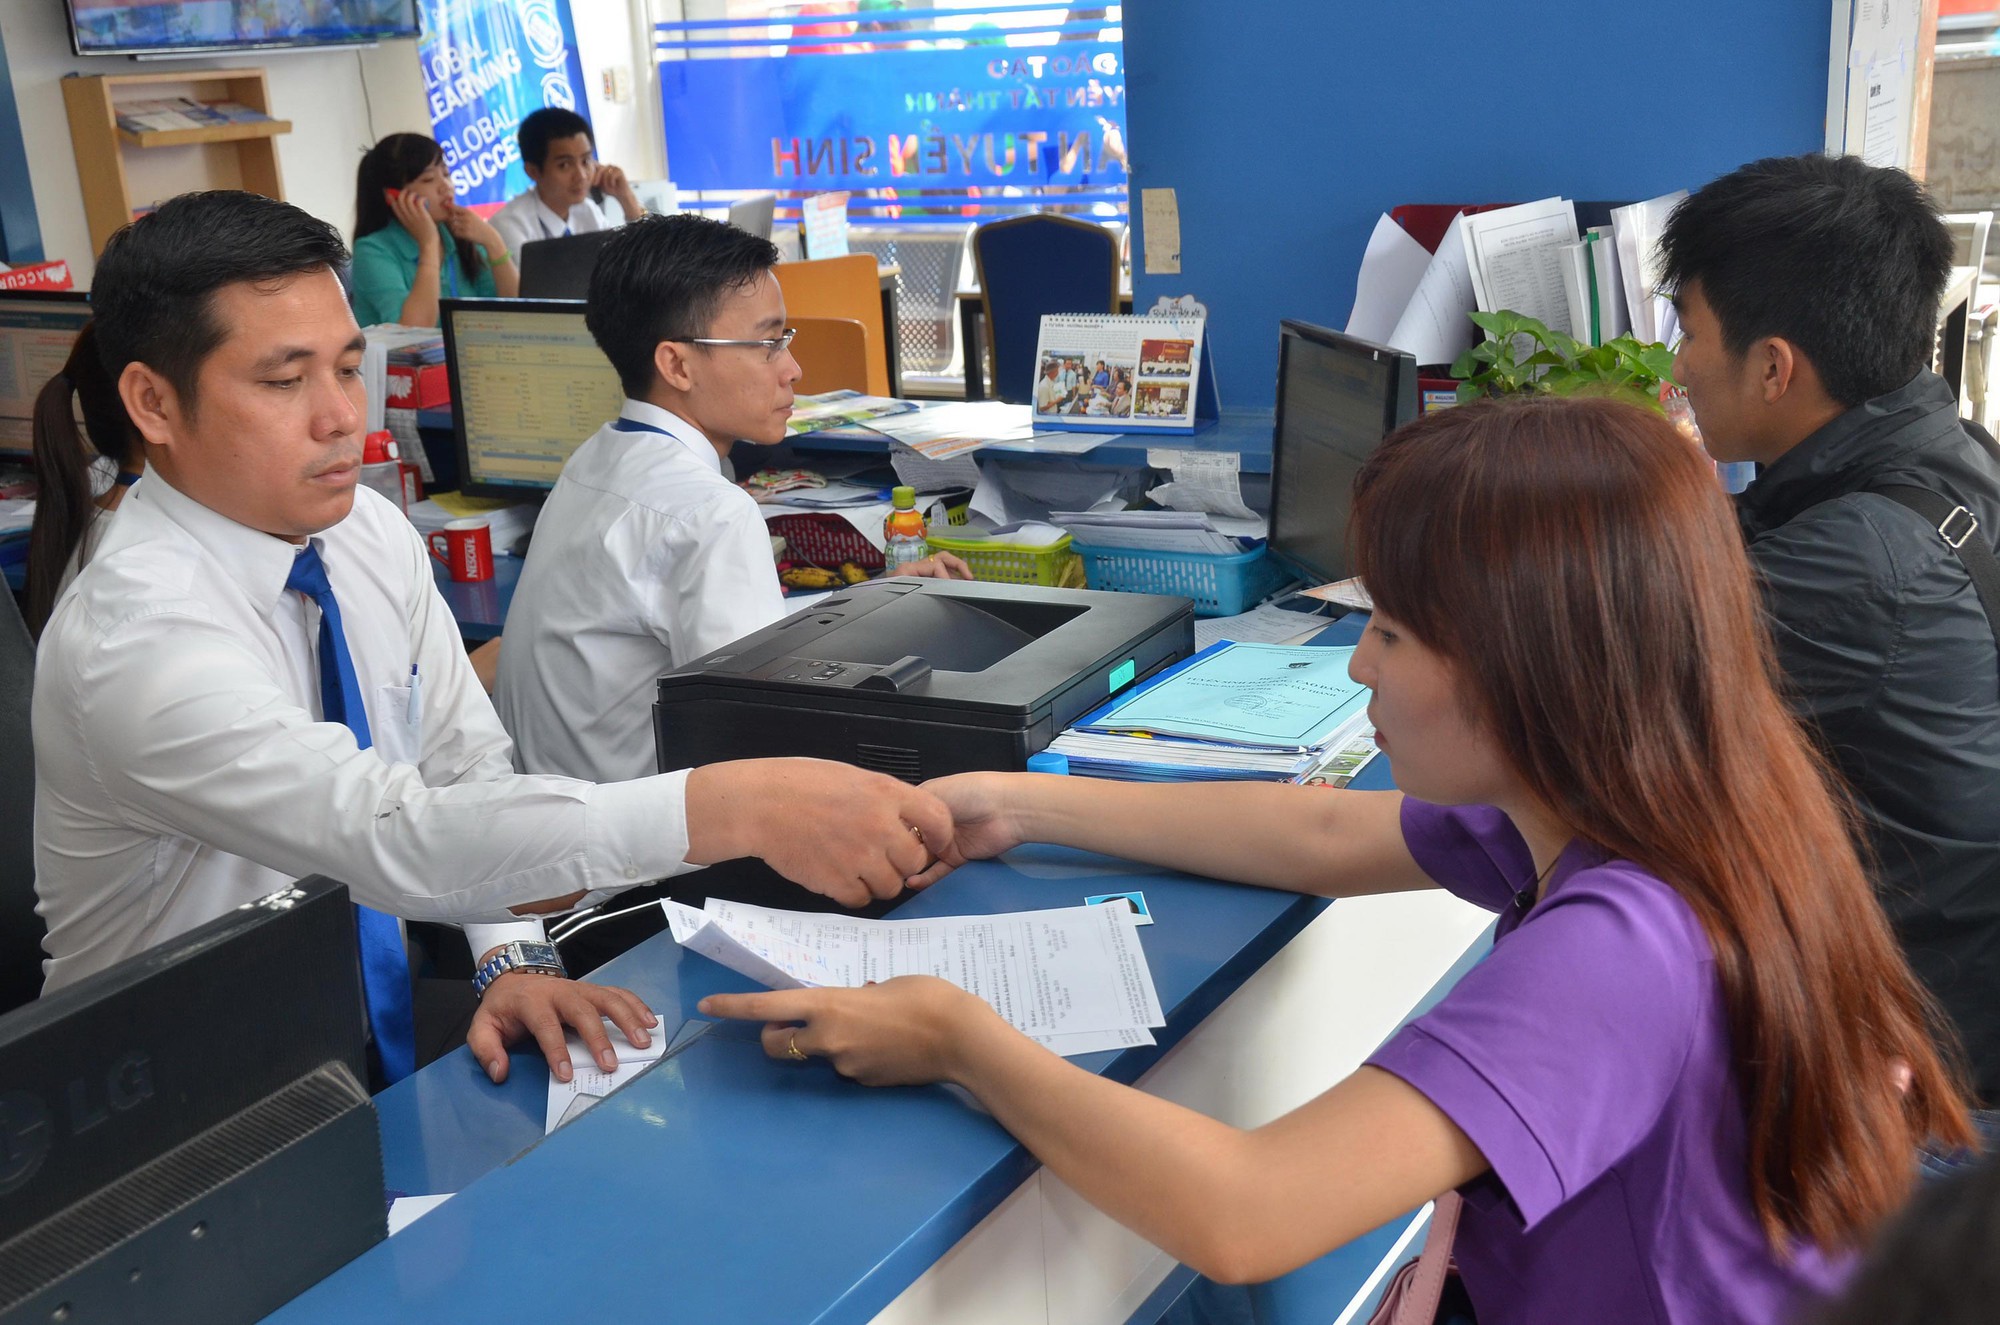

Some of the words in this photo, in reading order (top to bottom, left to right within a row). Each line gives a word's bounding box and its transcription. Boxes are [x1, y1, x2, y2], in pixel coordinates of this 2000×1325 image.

[421, 38, 489, 92] LOBAL
[441, 104, 520, 166] GLOBAL
[452, 132, 521, 196] SUCCE
[67, 1055, 155, 1136] LG
